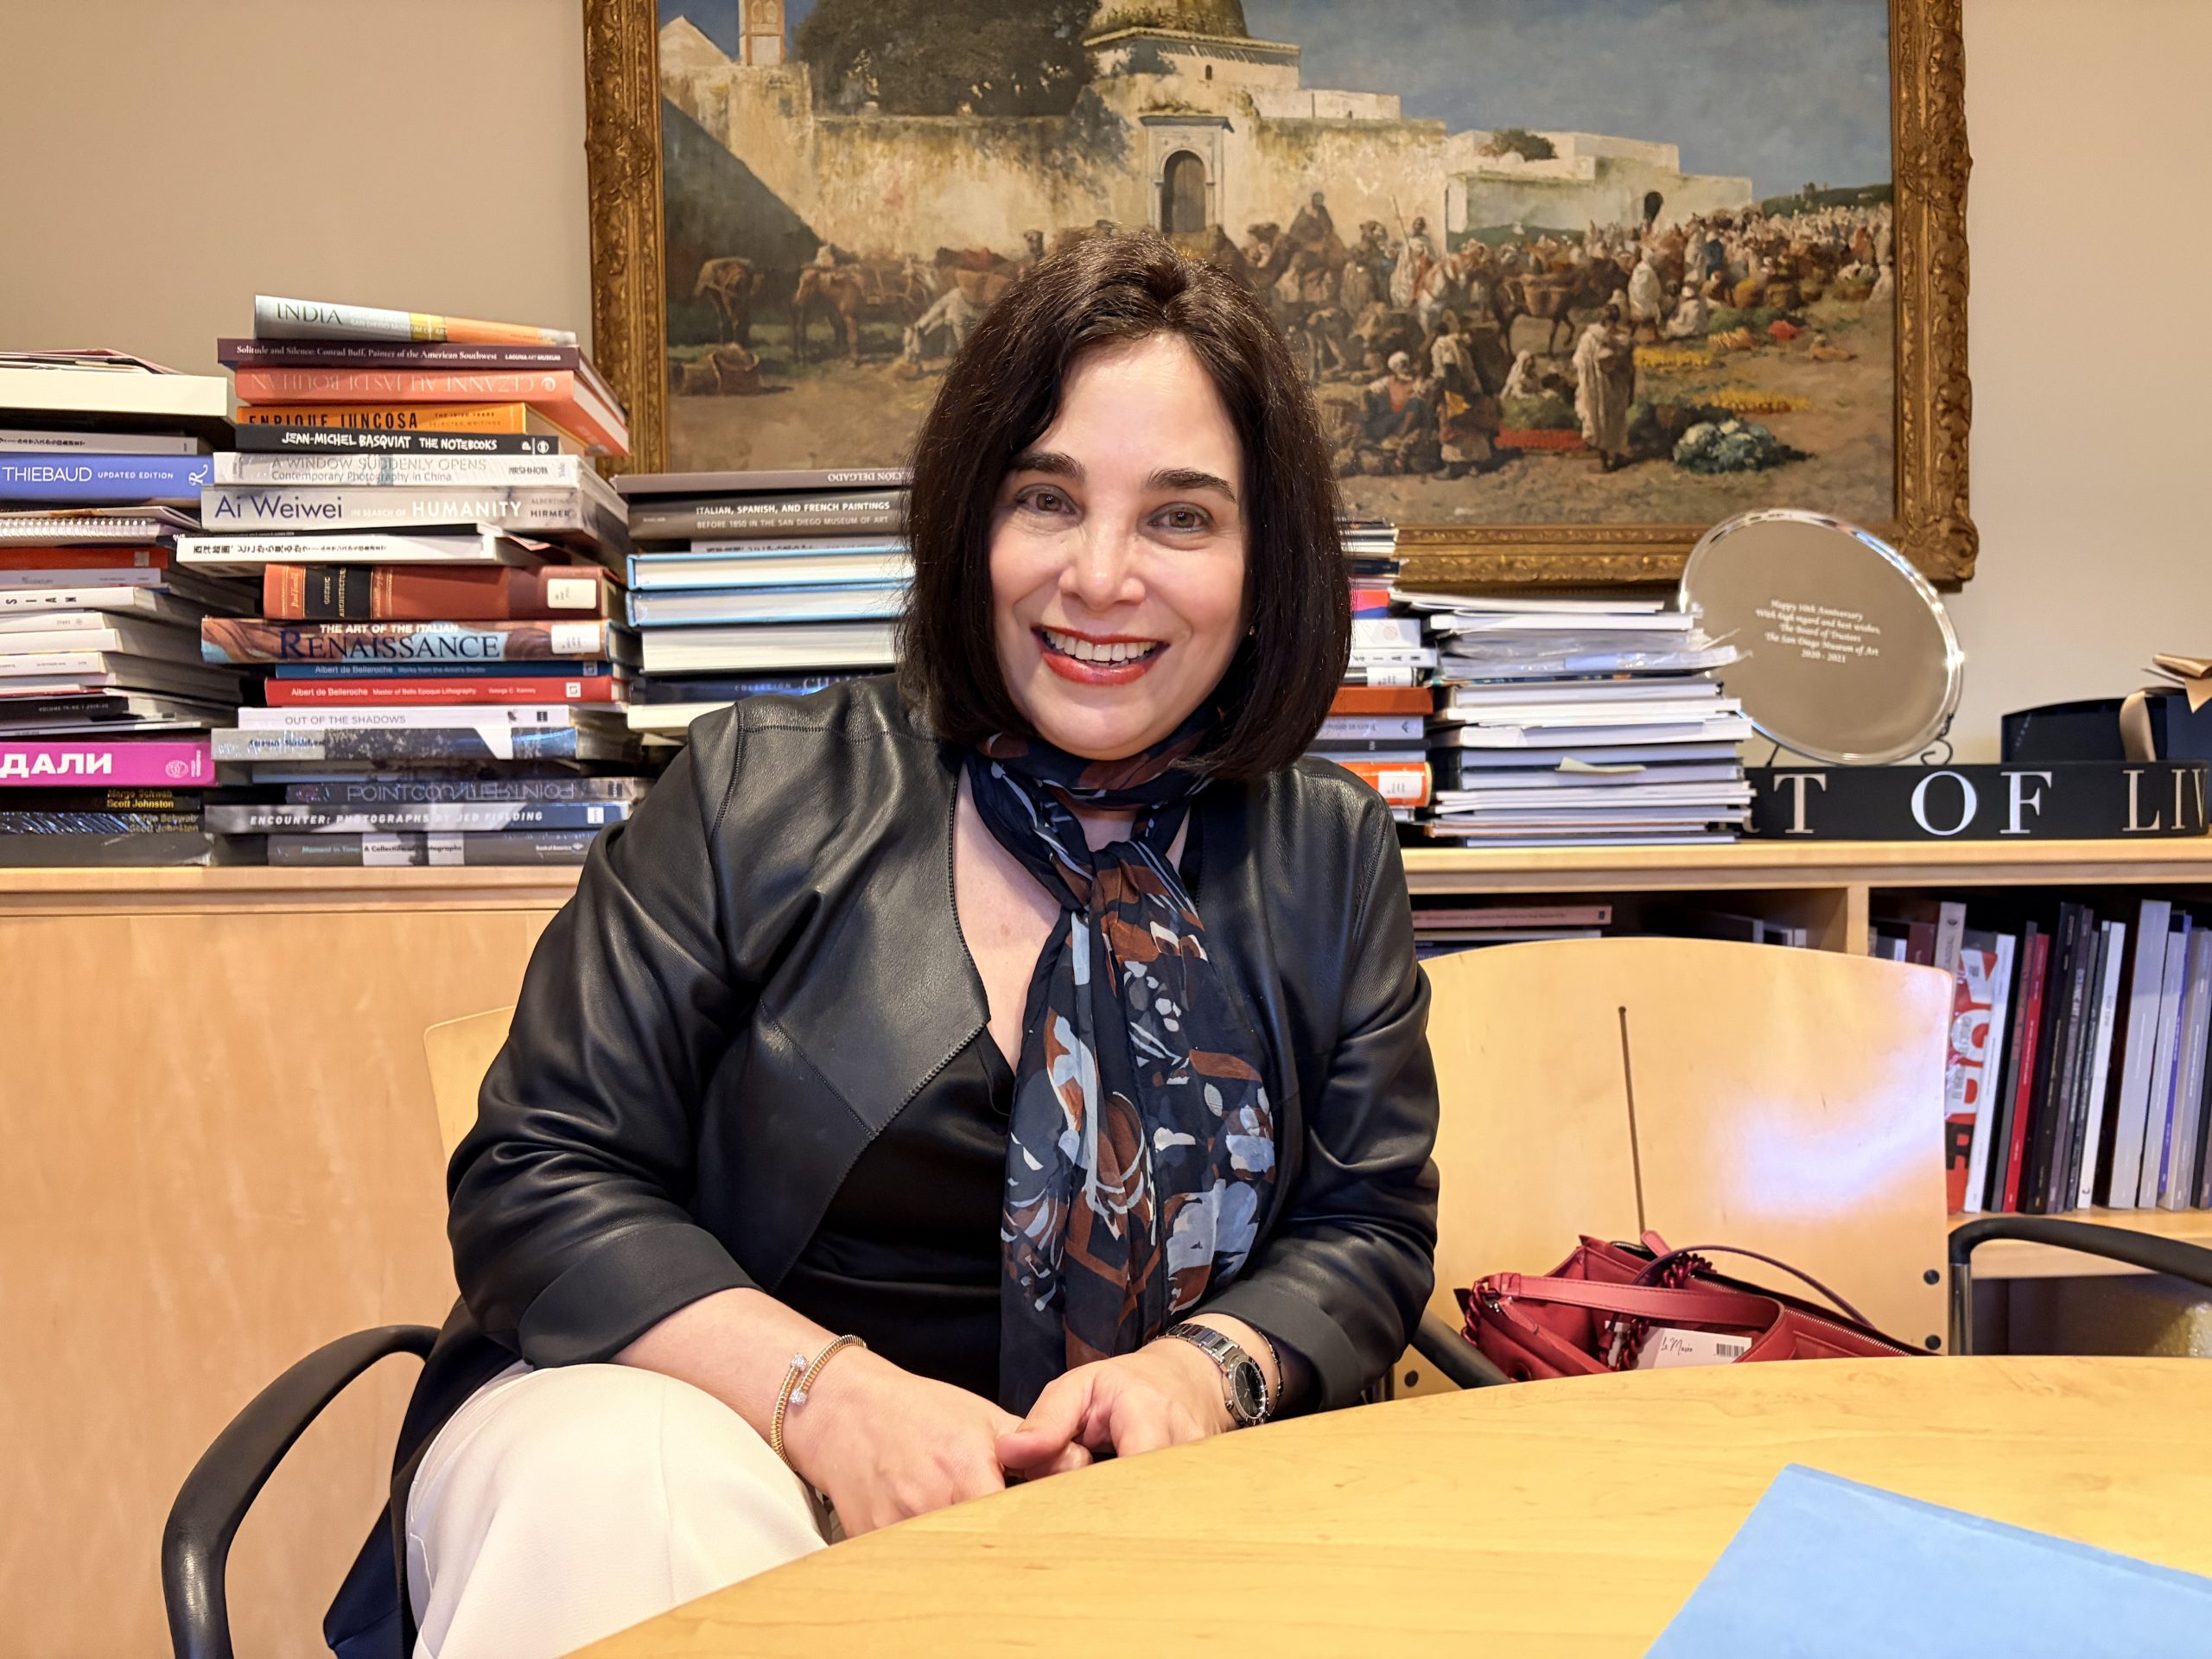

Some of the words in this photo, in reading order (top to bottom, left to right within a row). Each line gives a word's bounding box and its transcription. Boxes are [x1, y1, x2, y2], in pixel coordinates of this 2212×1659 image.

[276, 302, 344, 326] INDIA
[237, 345, 269, 354] Solitude
[368, 349, 395, 358] Painter
[408, 350, 419, 359] the
[421, 351, 458, 359] American
[459, 351, 498, 360] Southwest
[373, 374, 402, 391] JAS
[411, 375, 438, 392] AU
[249, 414, 328, 429] ENRIQUE
[282, 432, 357, 446] JEAN-MICHEL
[359, 434, 411, 449] BASQUIAT
[419, 437, 438, 449] THE
[441, 438, 498, 451] NOTEBOOKS
[271, 457, 283, 468] A
[286, 457, 353, 469] WINDOW
[359, 458, 437, 470] SUDDENLY
[438, 458, 487, 470] OPENS
[2, 467, 92, 482] THIEBAUD
[271, 471, 344, 483] Contemporary
[347, 471, 408, 484] Photography
[412, 473, 422, 481] in
[424, 472, 452, 482] China
[827, 473, 875, 483] DELGADO
[214, 494, 241, 518] Ai
[250, 495, 342, 518] Weiwei
[362, 508, 394, 517] SEARCH
[395, 508, 407, 517] OF
[412, 501, 522, 518] HUMANITY
[696, 505, 734, 515] ITALIAN,
[737, 505, 779, 514] SPANISH,
[781, 504, 801, 512] AND
[804, 503, 839, 512] FRENCH
[842, 501, 891, 512] PAINTINGS
[531, 510, 572, 518] HIRMER
[823, 517, 858, 525] MUSEUM
[1770, 599, 1797, 614] Happy
[1817, 606, 1863, 622] Anniversary
[1755, 608, 1777, 619] With
[1777, 612, 1795, 623] high
[1796, 614, 1820, 626] regard
[1821, 618, 1836, 627] and
[1836, 620, 1853, 630] best
[320, 624, 343, 634] THE
[345, 624, 370, 634] ART
[372, 624, 387, 633] OF
[390, 624, 412, 633] THE
[416, 624, 459, 633] ITALIAN
[1779, 622, 1794, 632] The
[1796, 625, 1819, 637] Board
[1820, 627, 1830, 639] of
[1831, 630, 1862, 642] Trustees
[279, 629, 500, 660] RENAISSANCE
[1764, 631, 1780, 642] The
[1781, 634, 1796, 645] San
[1797, 636, 1821, 649] Diego
[1822, 640, 1854, 652] Museum
[1854, 645, 1865, 657] of
[1866, 646, 1879, 657] Art
[315, 665, 339, 674] Albert
[340, 665, 351, 674] de
[353, 665, 393, 674] Belleroche
[291, 688, 315, 696] Albert
[316, 688, 327, 696] de
[327, 688, 368, 696] Belleroche
[442, 688, 477, 696] Lithography
[285, 715, 306, 726] OUT
[310, 716, 324, 725] OF
[329, 715, 348, 725] THE
[352, 715, 406, 725] SHADOWS
[0, 753, 112, 778] ДАЛИ
[138, 789, 173, 798] Schwab
[107, 799, 130, 808] Scott
[132, 799, 174, 809] Johnston
[1910, 770, 2053, 836] OF
[2122, 768, 2209, 832] LIV
[250, 815, 331, 825] ENCOUNTER:
[336, 813, 430, 824] PHOTOGRAPHS
[456, 812, 479, 823] JED
[484, 810, 543, 822] FIELDING
